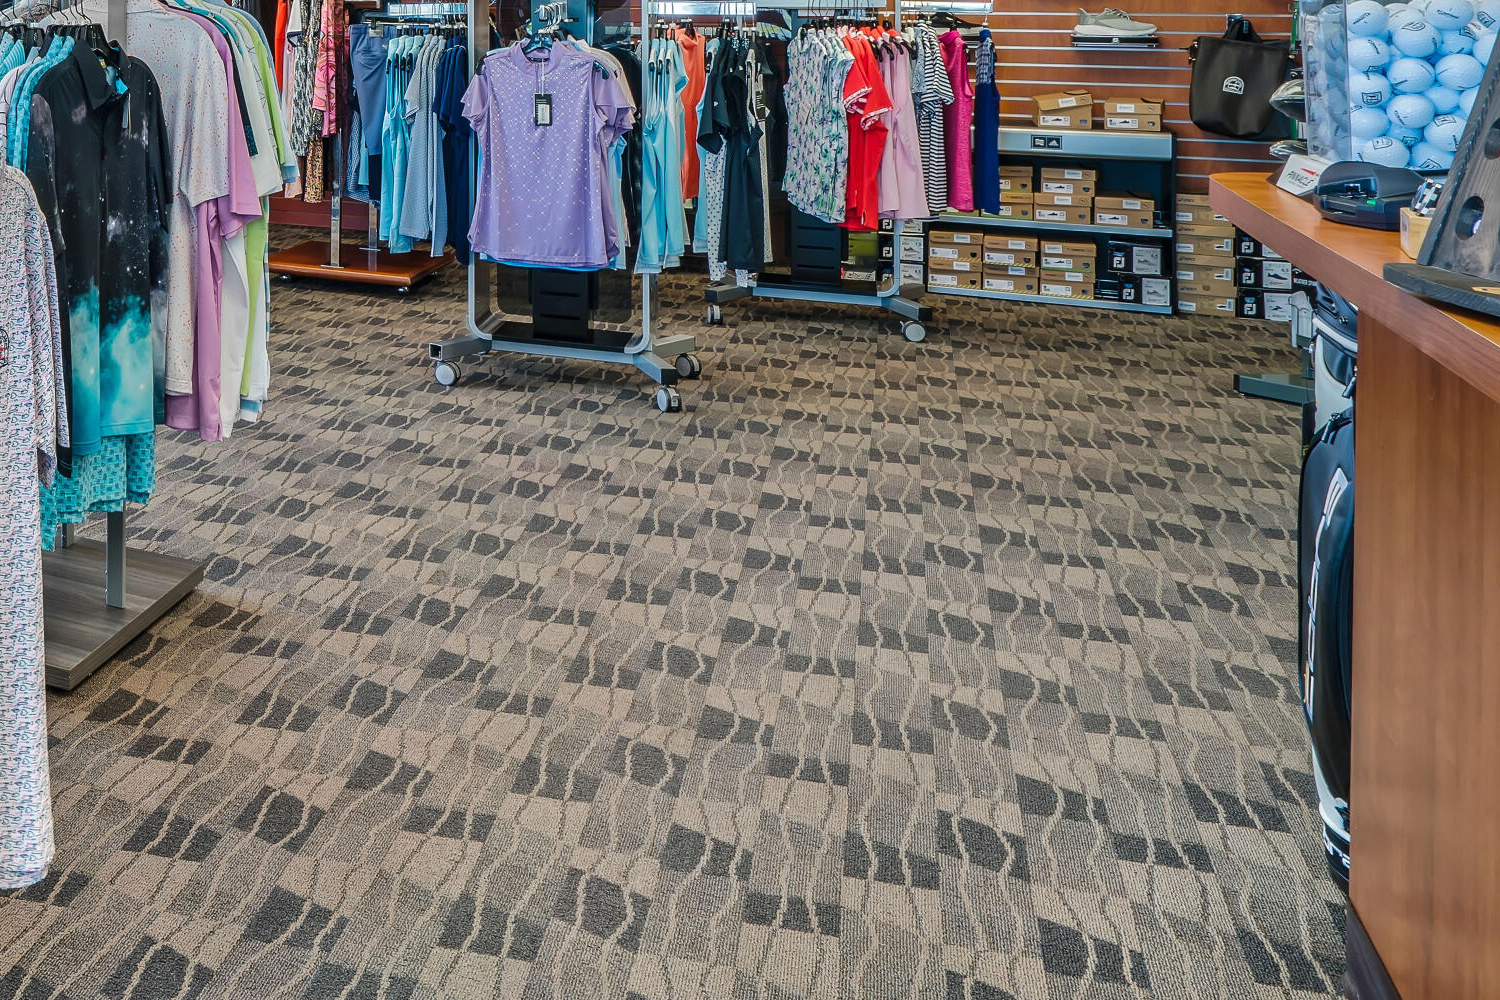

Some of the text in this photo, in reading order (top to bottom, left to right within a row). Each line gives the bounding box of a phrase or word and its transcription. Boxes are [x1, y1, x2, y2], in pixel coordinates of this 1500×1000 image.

[882, 246, 893, 258] FJ
[1241, 241, 1254, 254] FJ
[1113, 256, 1125, 268] FJ
[1242, 272, 1255, 284] FJ
[1122, 288, 1134, 300] FJ
[1244, 303, 1257, 315] FJ
